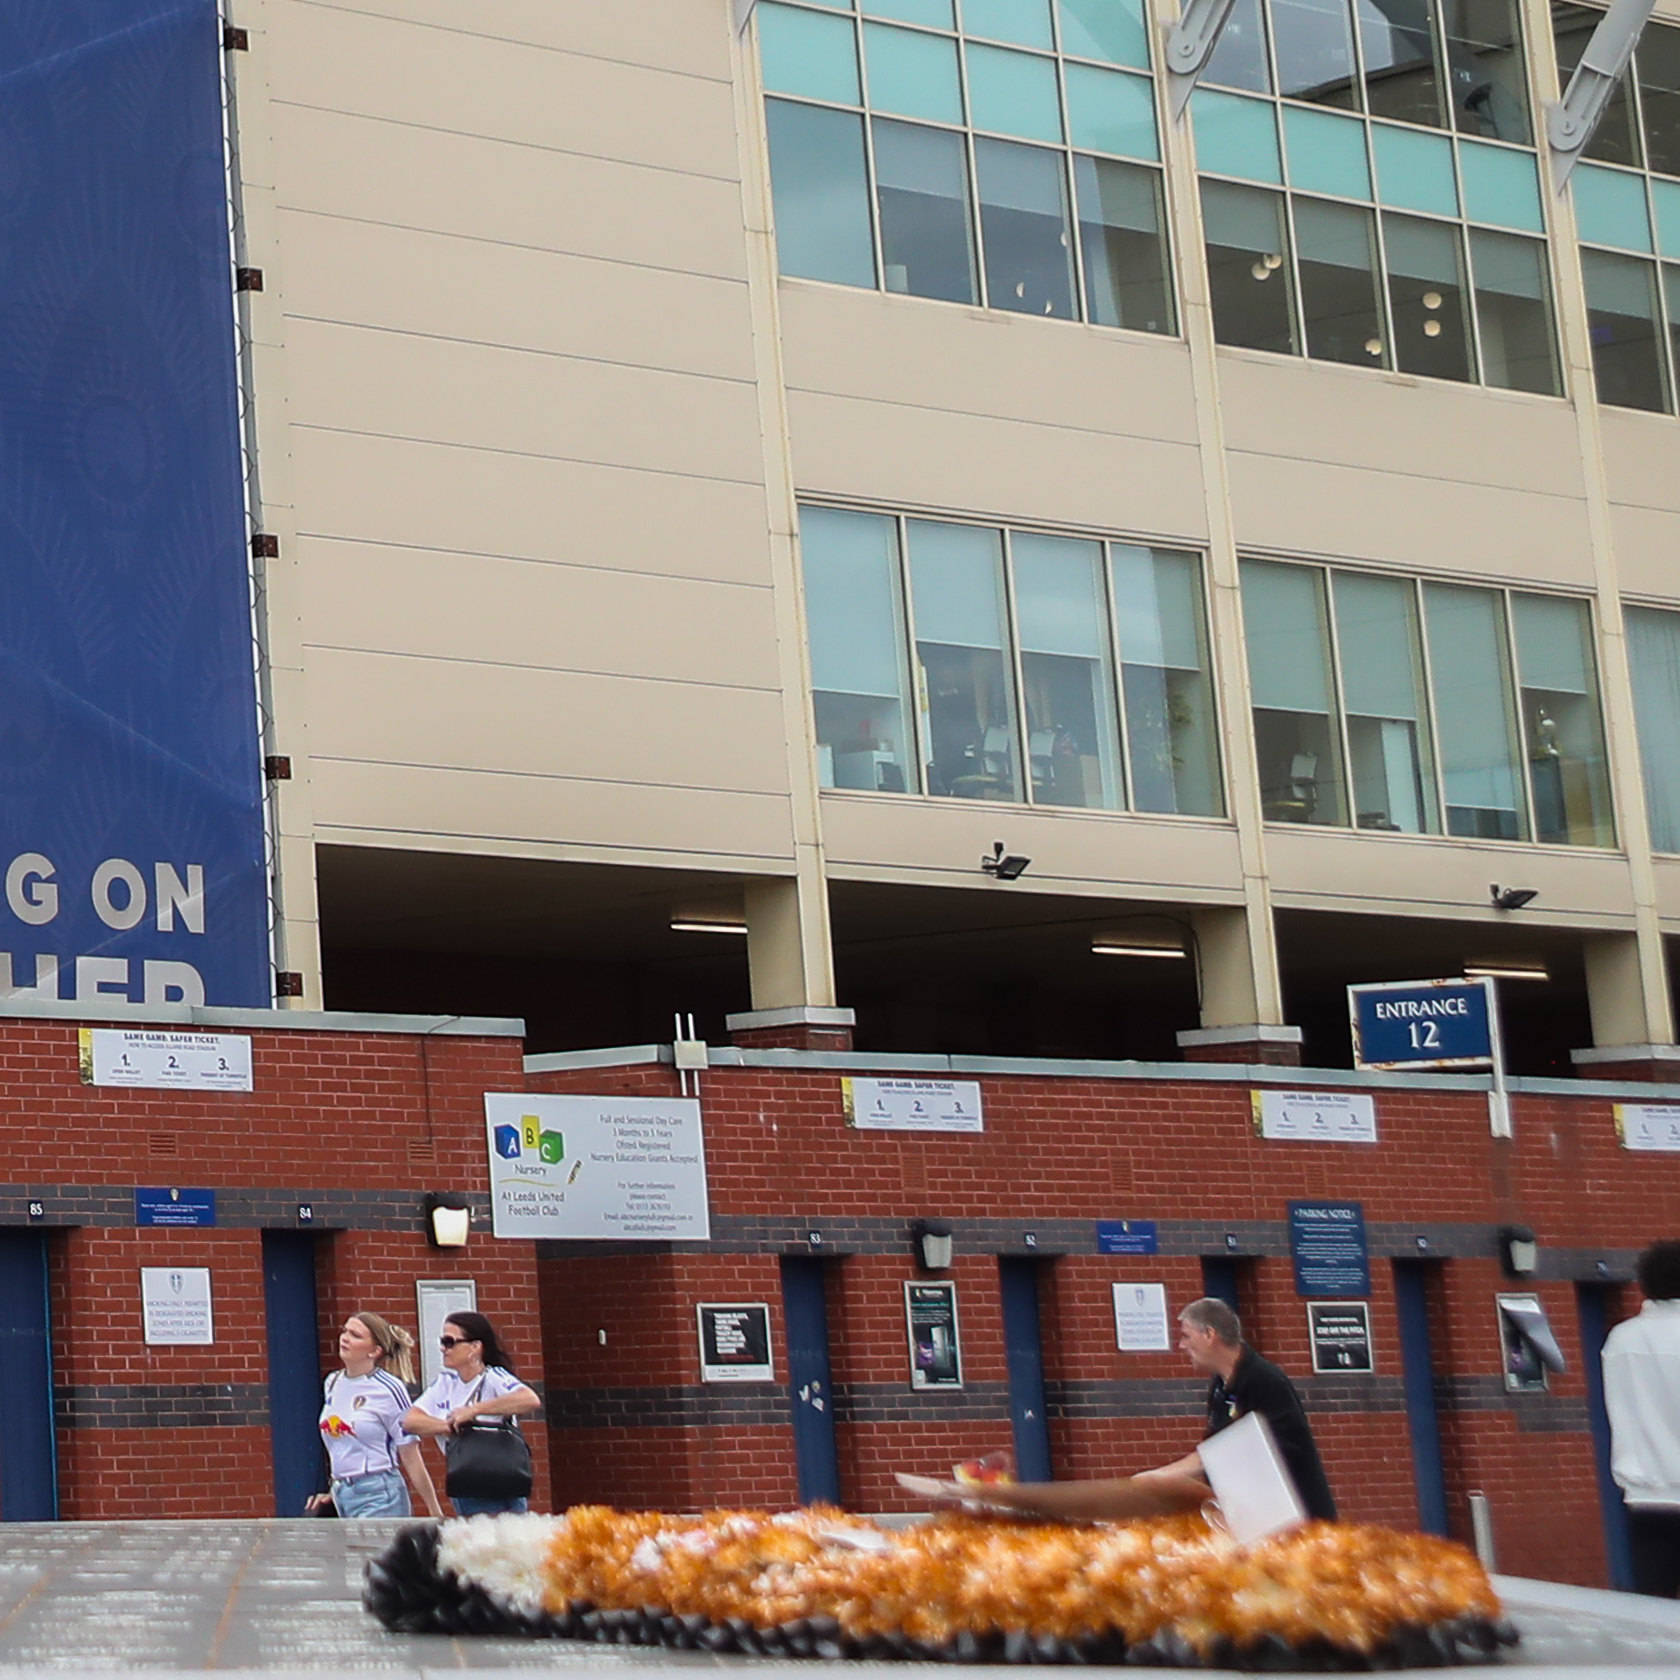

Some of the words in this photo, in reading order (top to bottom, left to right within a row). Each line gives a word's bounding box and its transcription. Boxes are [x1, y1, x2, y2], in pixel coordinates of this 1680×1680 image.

[92, 858, 206, 935] ON
[1376, 997, 1468, 1019] ENTRANCE
[1408, 1021, 1440, 1048] 12
[514, 1165, 547, 1176] Nursery
[513, 1191, 536, 1201] Leeds
[538, 1192, 564, 1202] United
[298, 1205, 312, 1219] 84
[508, 1205, 539, 1216] Football
[542, 1205, 559, 1216] Club
